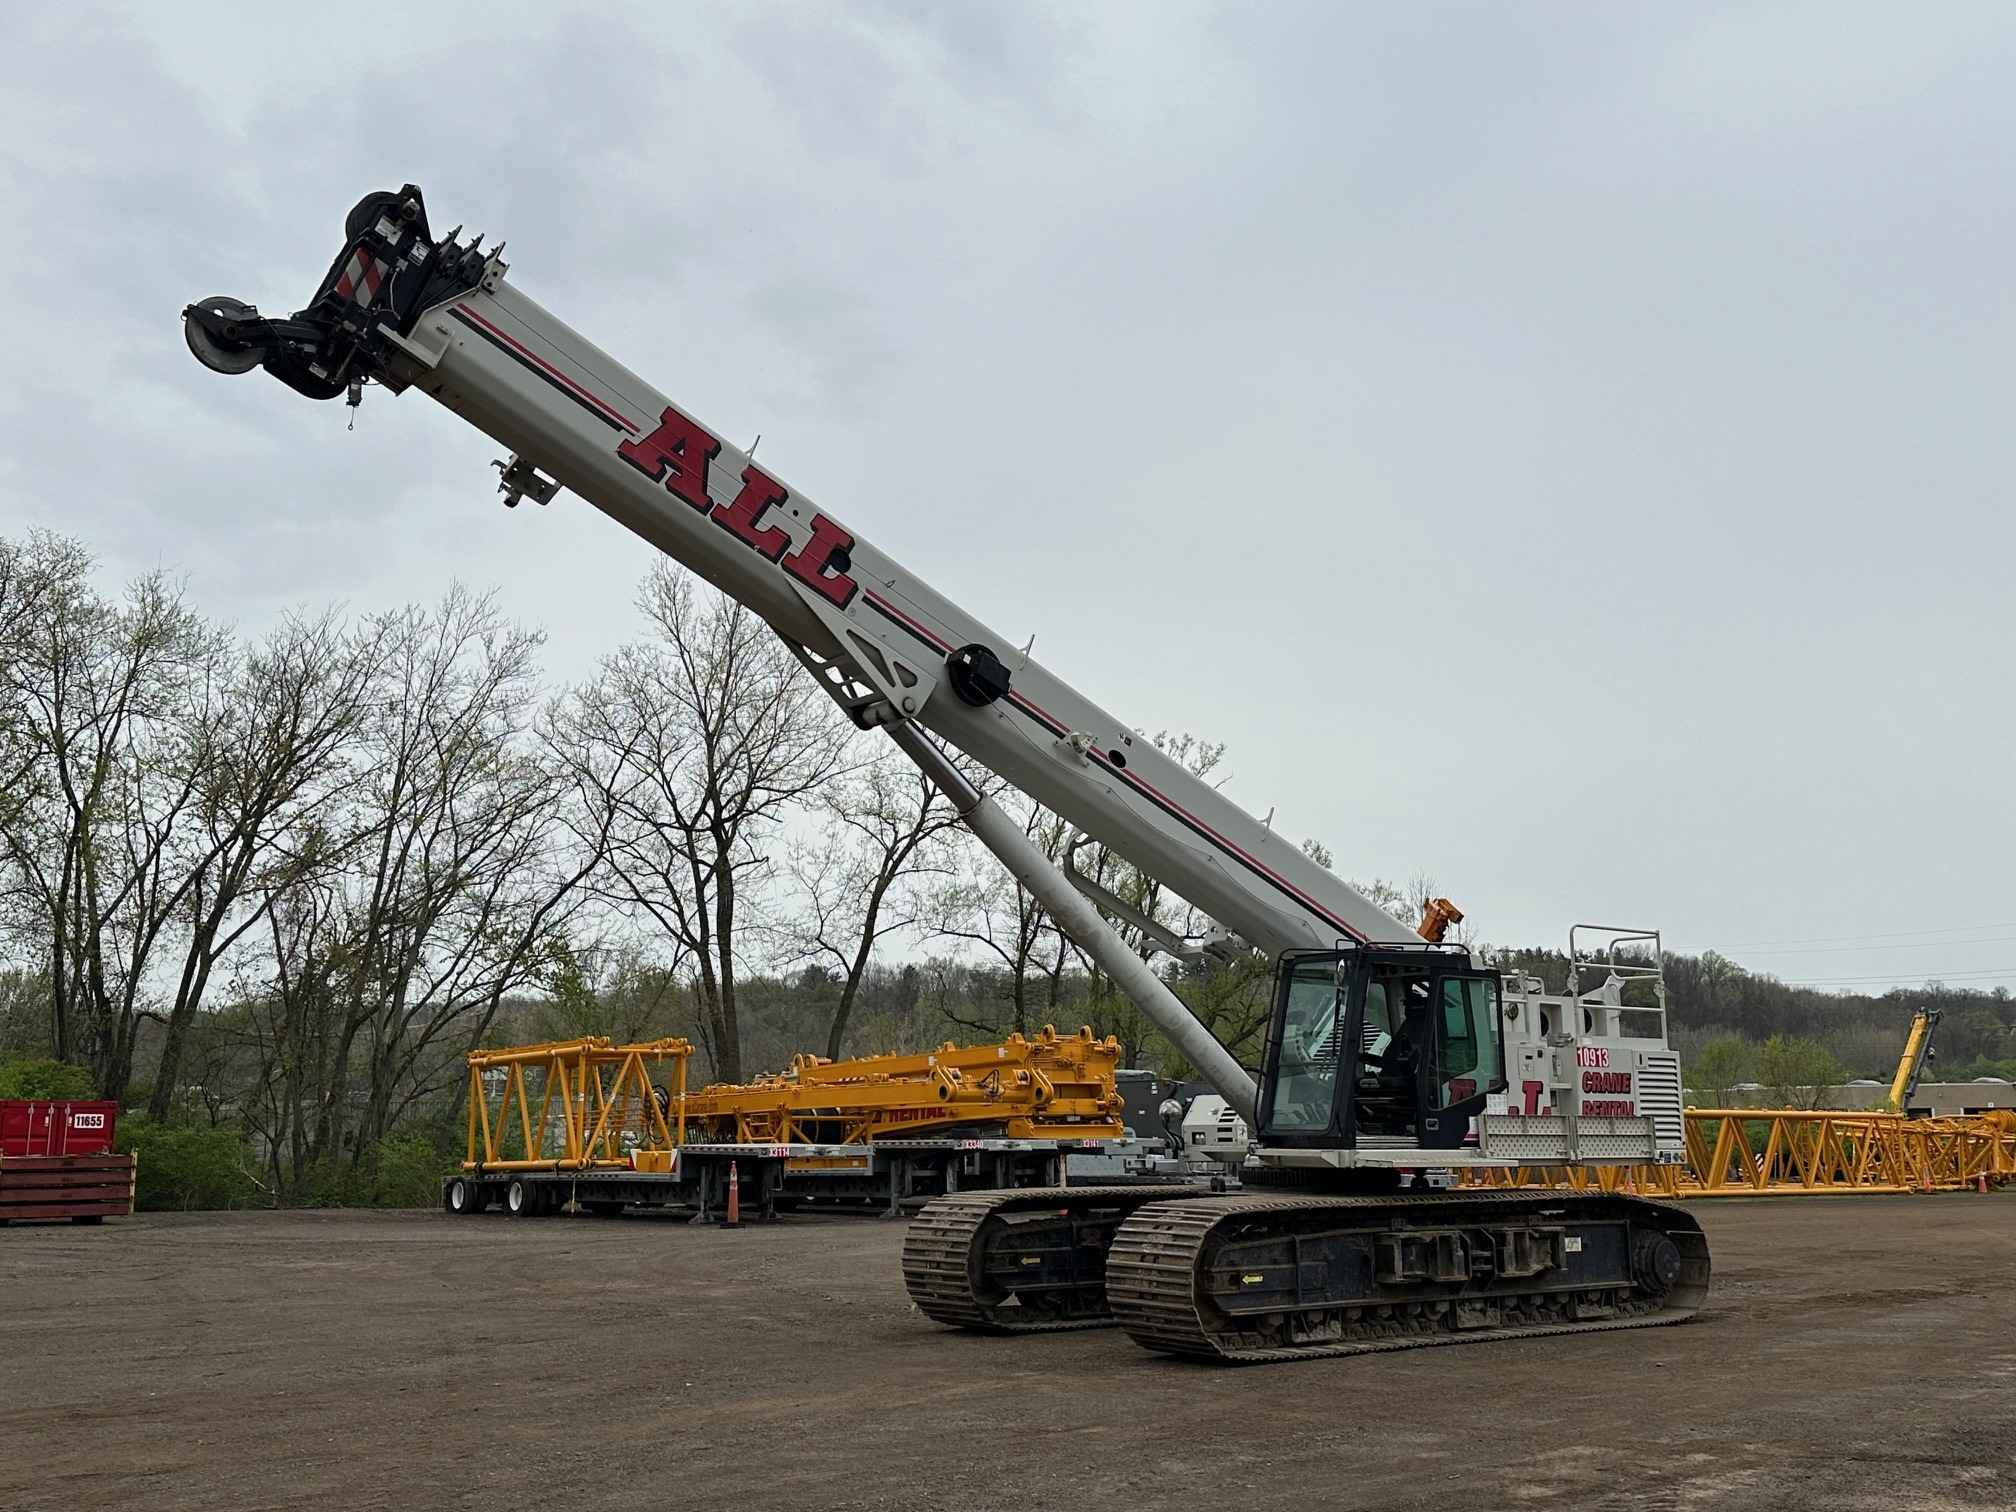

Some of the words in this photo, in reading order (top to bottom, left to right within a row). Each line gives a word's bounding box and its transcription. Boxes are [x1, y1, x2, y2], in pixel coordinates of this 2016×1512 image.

[617, 405, 859, 611] ALL
[1577, 1048, 1609, 1067] 10913
[1582, 1071, 1631, 1094] CRANE
[76, 1115, 102, 1127] 11655
